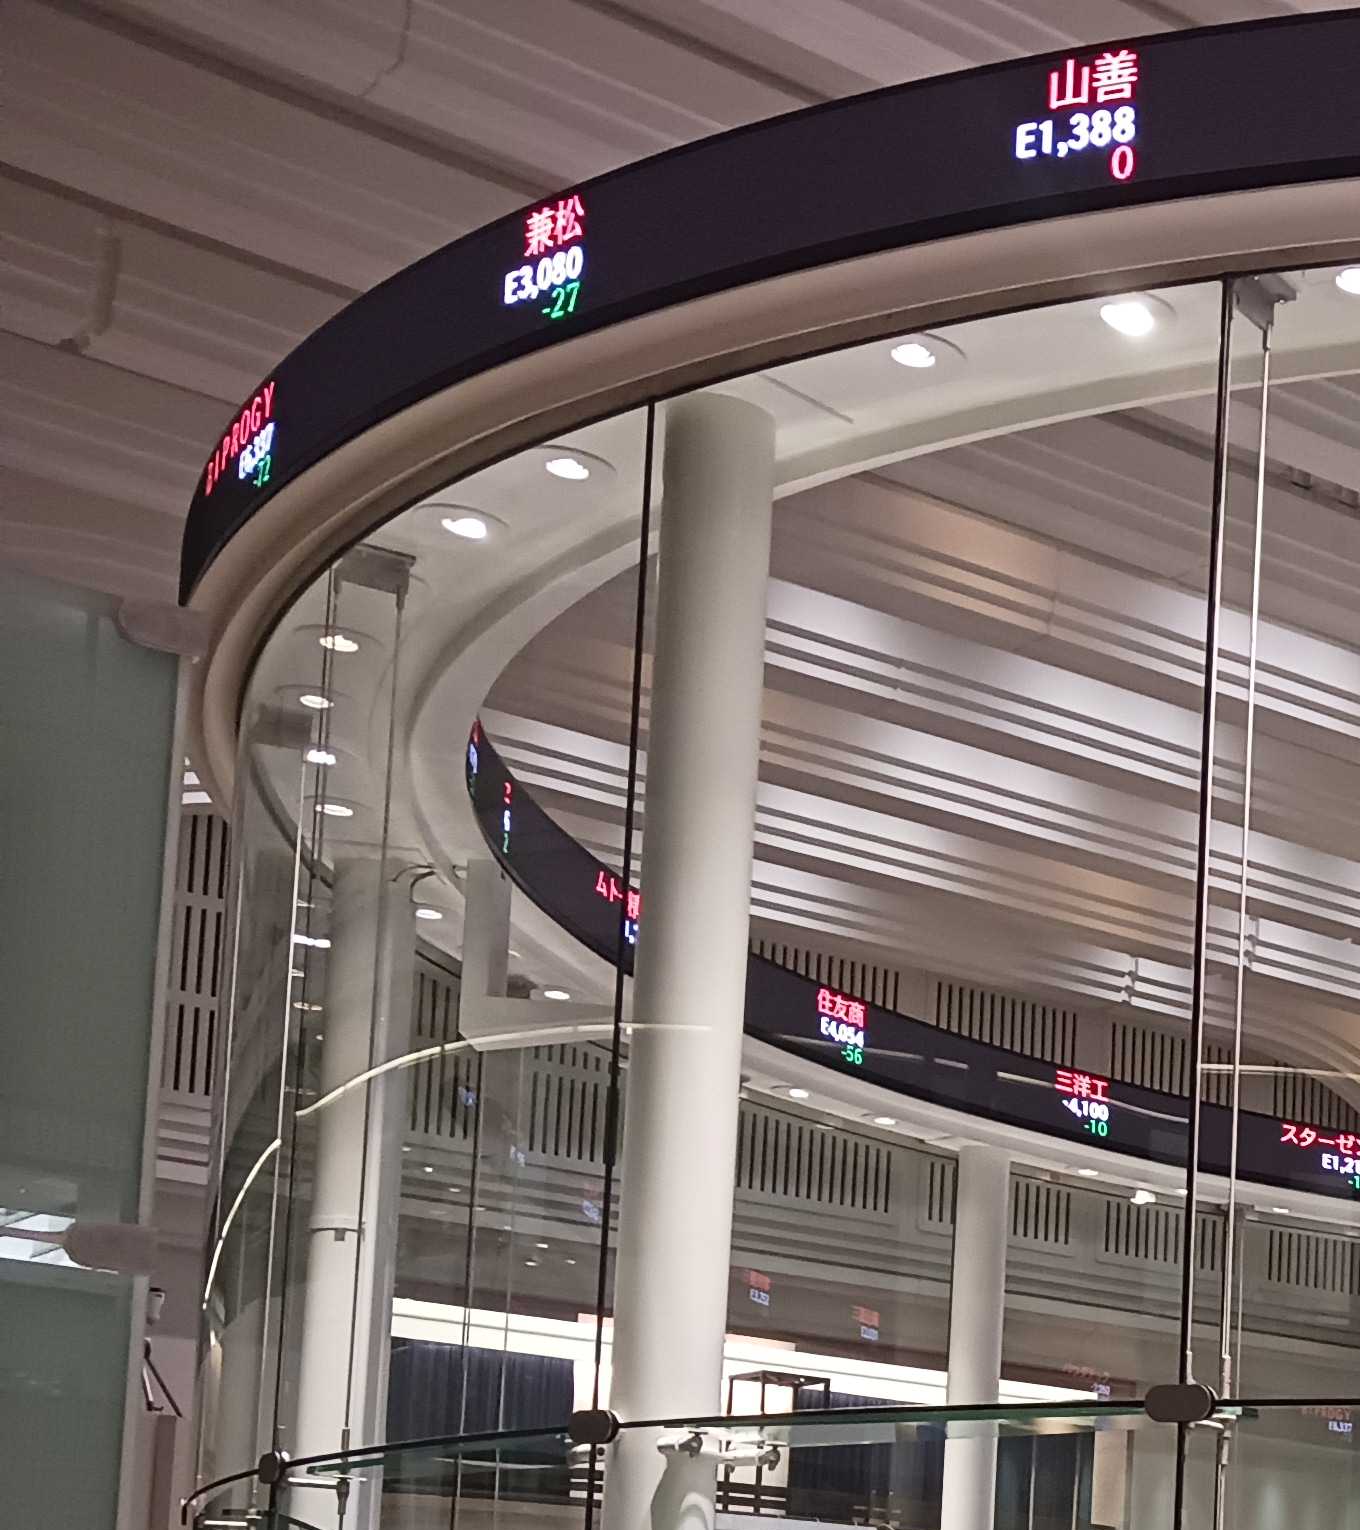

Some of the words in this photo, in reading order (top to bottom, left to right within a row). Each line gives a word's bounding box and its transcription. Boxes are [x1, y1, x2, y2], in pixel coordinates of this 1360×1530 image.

[1049, 50, 1138, 110] 山善
[1015, 105, 1136, 159] E1,388
[1111, 144, 1134, 180] 0
[524, 195, 585, 257] 兼松
[504, 246, 584, 304] E3,080
[542, 281, 580, 318] -27
[205, 381, 275, 496] BIPROGY
[817, 988, 865, 1028] 住友商
[841, 1044, 863, 1065] -56
[1055, 1070, 1109, 1102] 三洋工
[1083, 1119, 1108, 1137] -10
